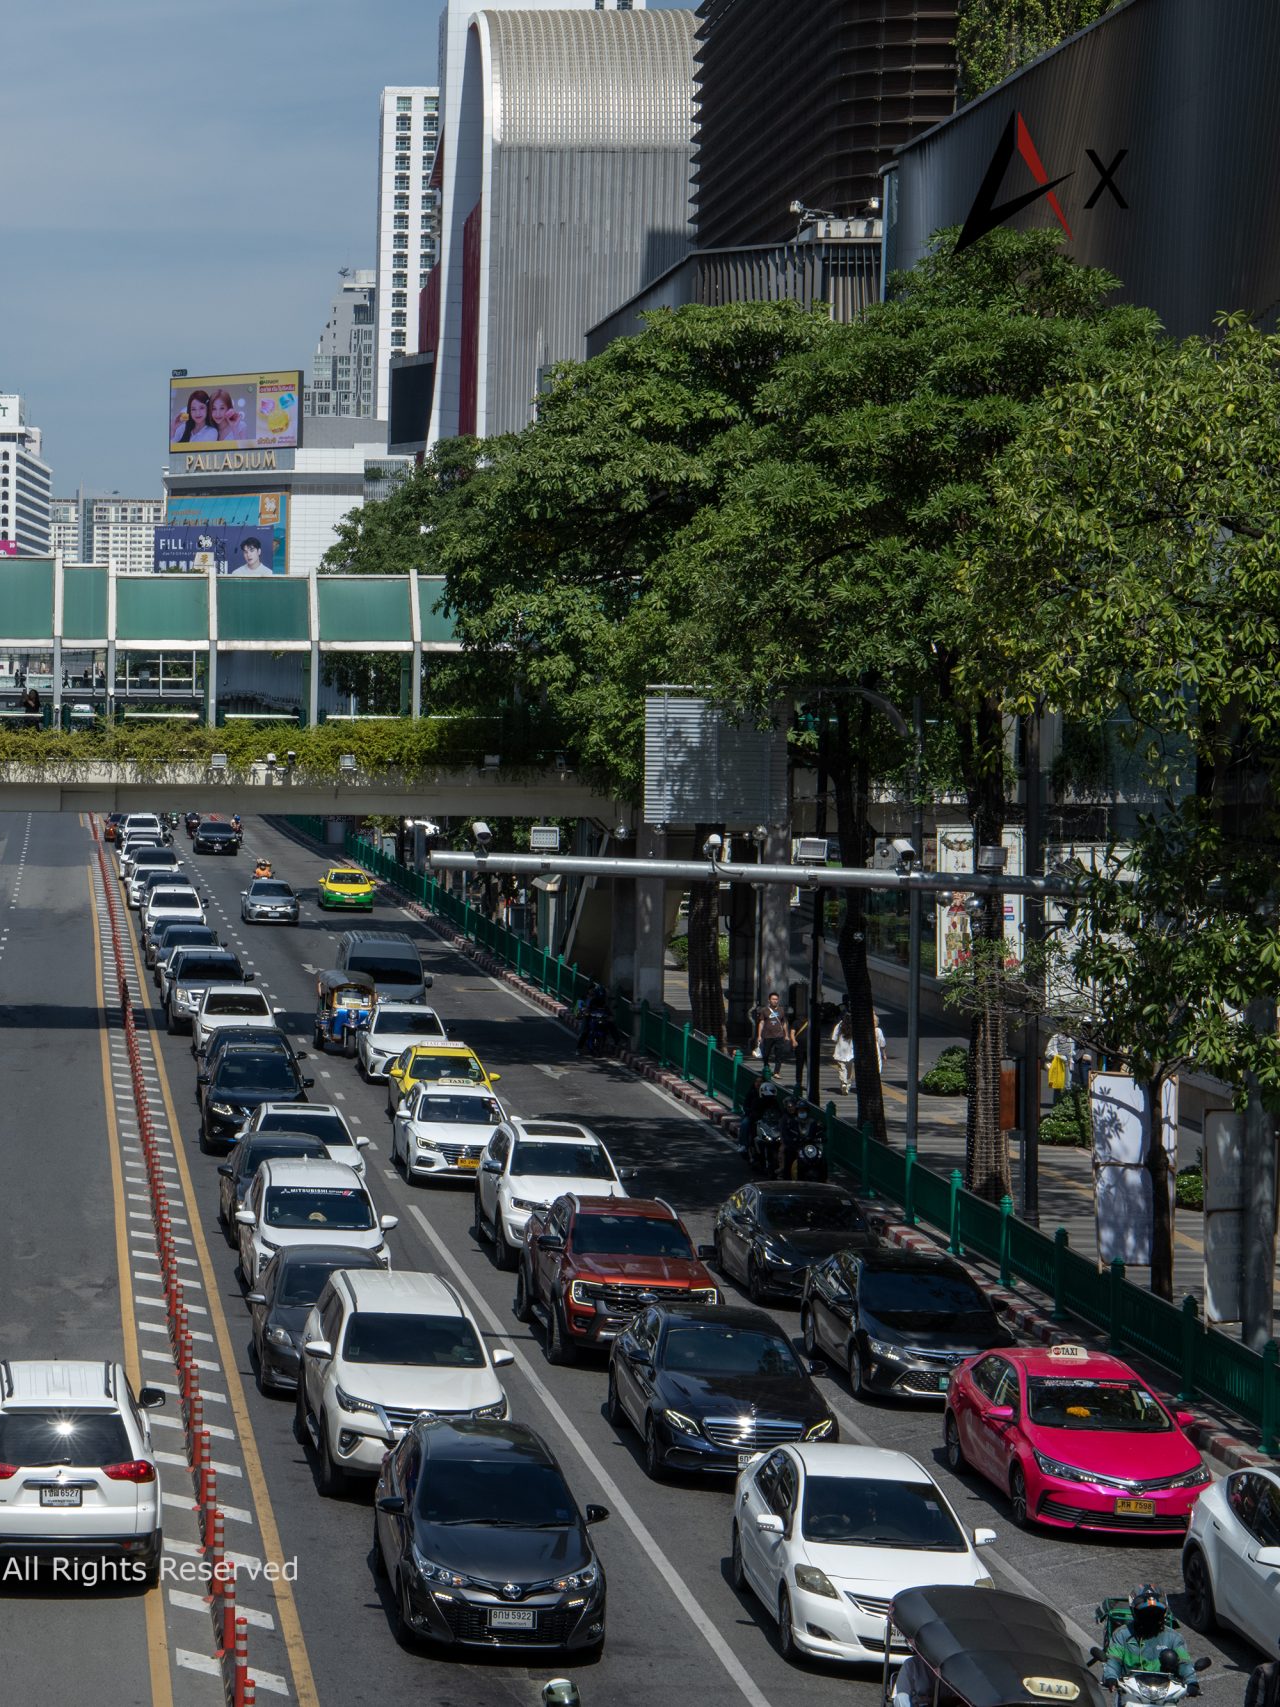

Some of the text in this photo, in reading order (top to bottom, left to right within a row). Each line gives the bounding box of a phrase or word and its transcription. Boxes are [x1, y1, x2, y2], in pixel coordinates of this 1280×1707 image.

[186, 454, 277, 470] PALLADIUM
[160, 538, 184, 550] FILL
[1061, 1347, 1078, 1356] TAXI
[61, 1489, 79, 1497] 6527
[1135, 1502, 1152, 1510] 7598
[511, 1611, 532, 1620] 5922
[1039, 1682, 1069, 1695] TAXI
